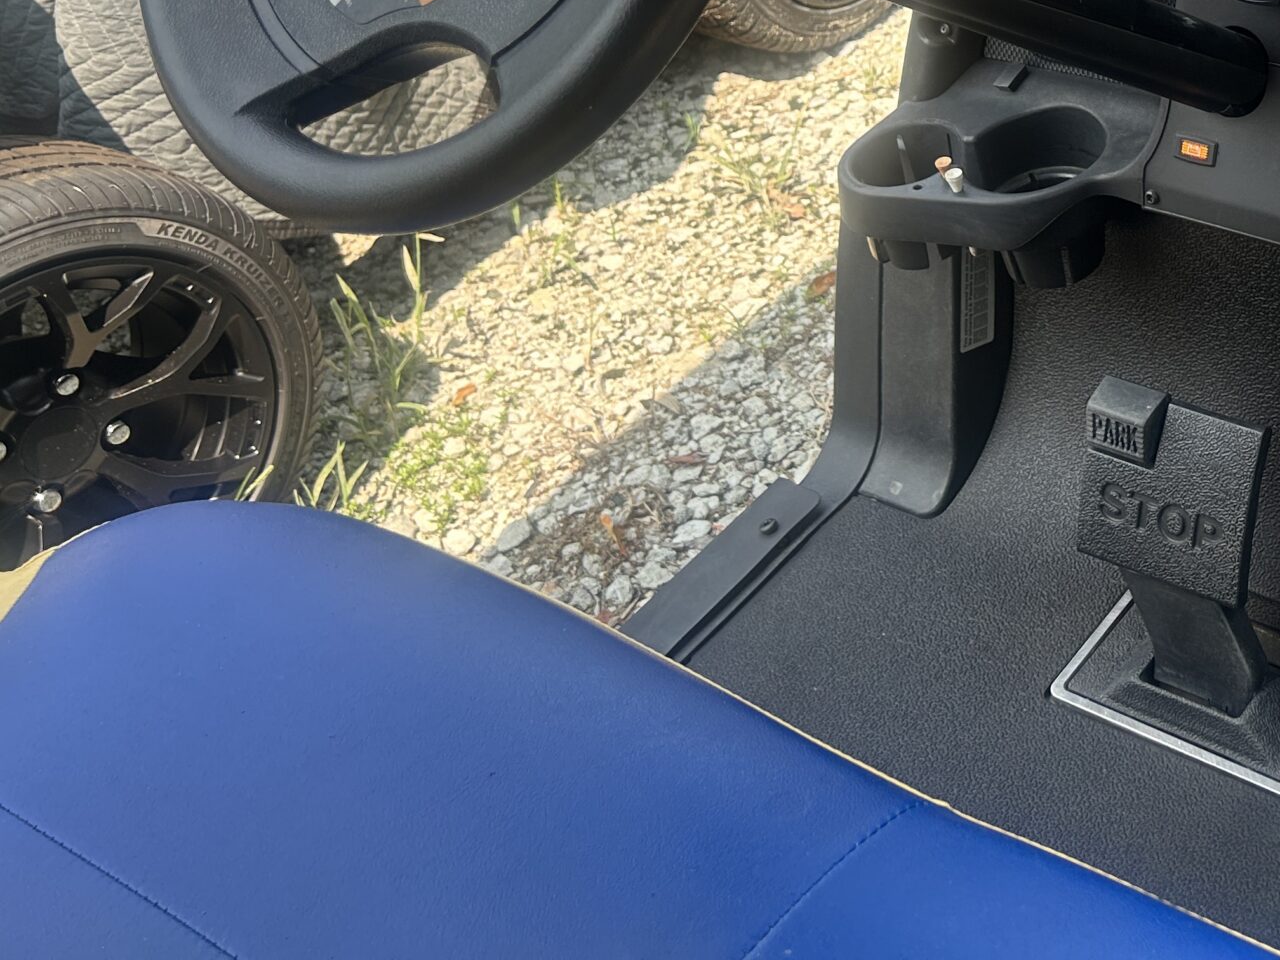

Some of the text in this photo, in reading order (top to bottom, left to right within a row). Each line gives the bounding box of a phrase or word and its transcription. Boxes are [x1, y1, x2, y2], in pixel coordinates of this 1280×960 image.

[156, 222, 219, 251] KENDA
[223, 247, 284, 306] KRUIZER
[1092, 413, 1138, 453] PARK
[1101, 482, 1225, 548] STOP
